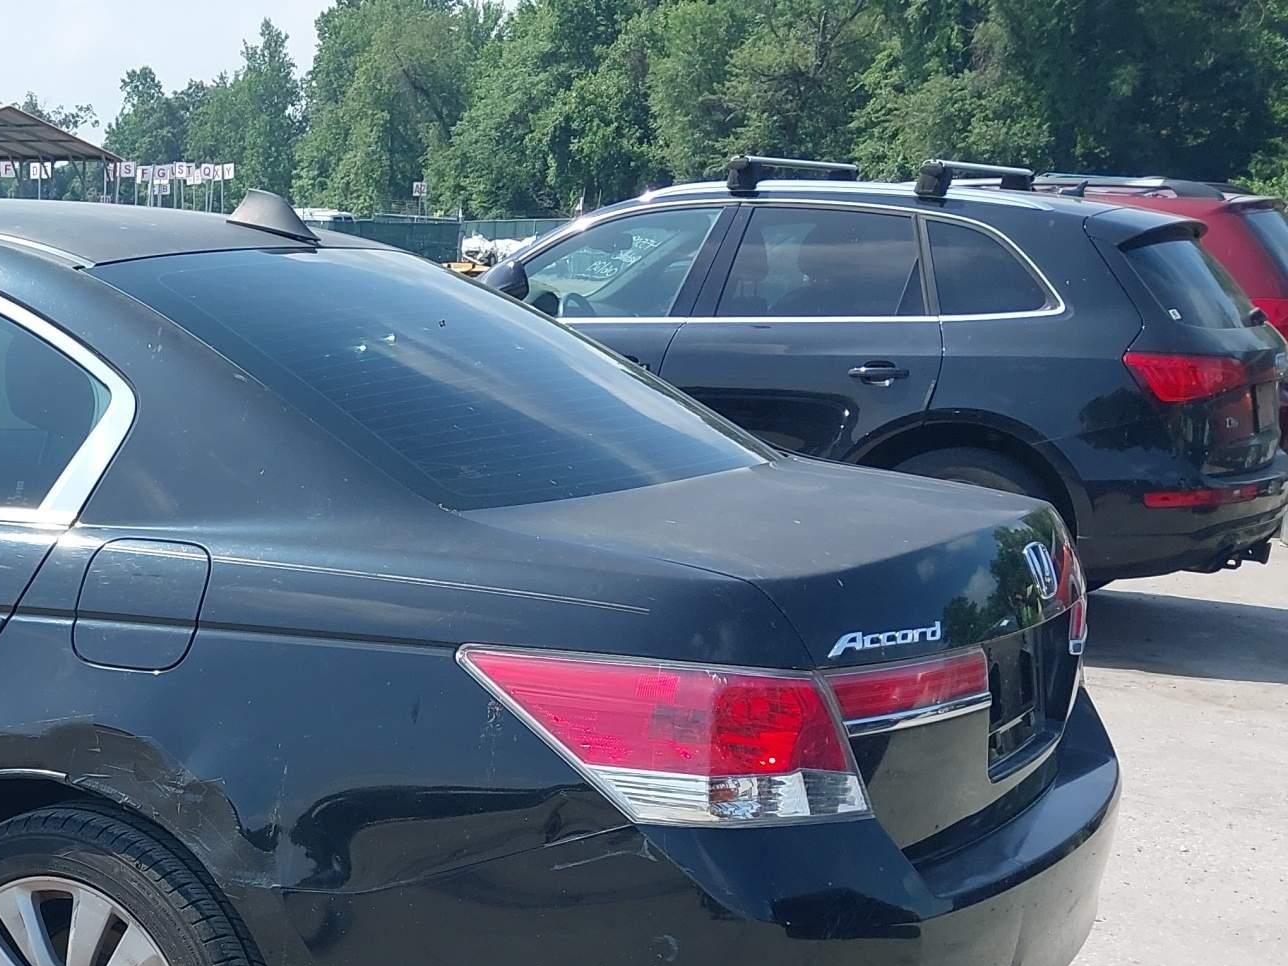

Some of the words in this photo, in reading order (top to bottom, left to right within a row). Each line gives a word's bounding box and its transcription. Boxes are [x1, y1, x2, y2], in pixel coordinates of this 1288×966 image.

[4, 164, 12, 175] F
[124, 164, 132, 175] S
[141, 168, 149, 178] F
[157, 168, 166, 178] G
[177, 164, 184, 175] S
[186, 165, 193, 175] T
[203, 166, 211, 177] Q
[225, 167, 232, 177] Y
[828, 621, 942, 658] Accord
